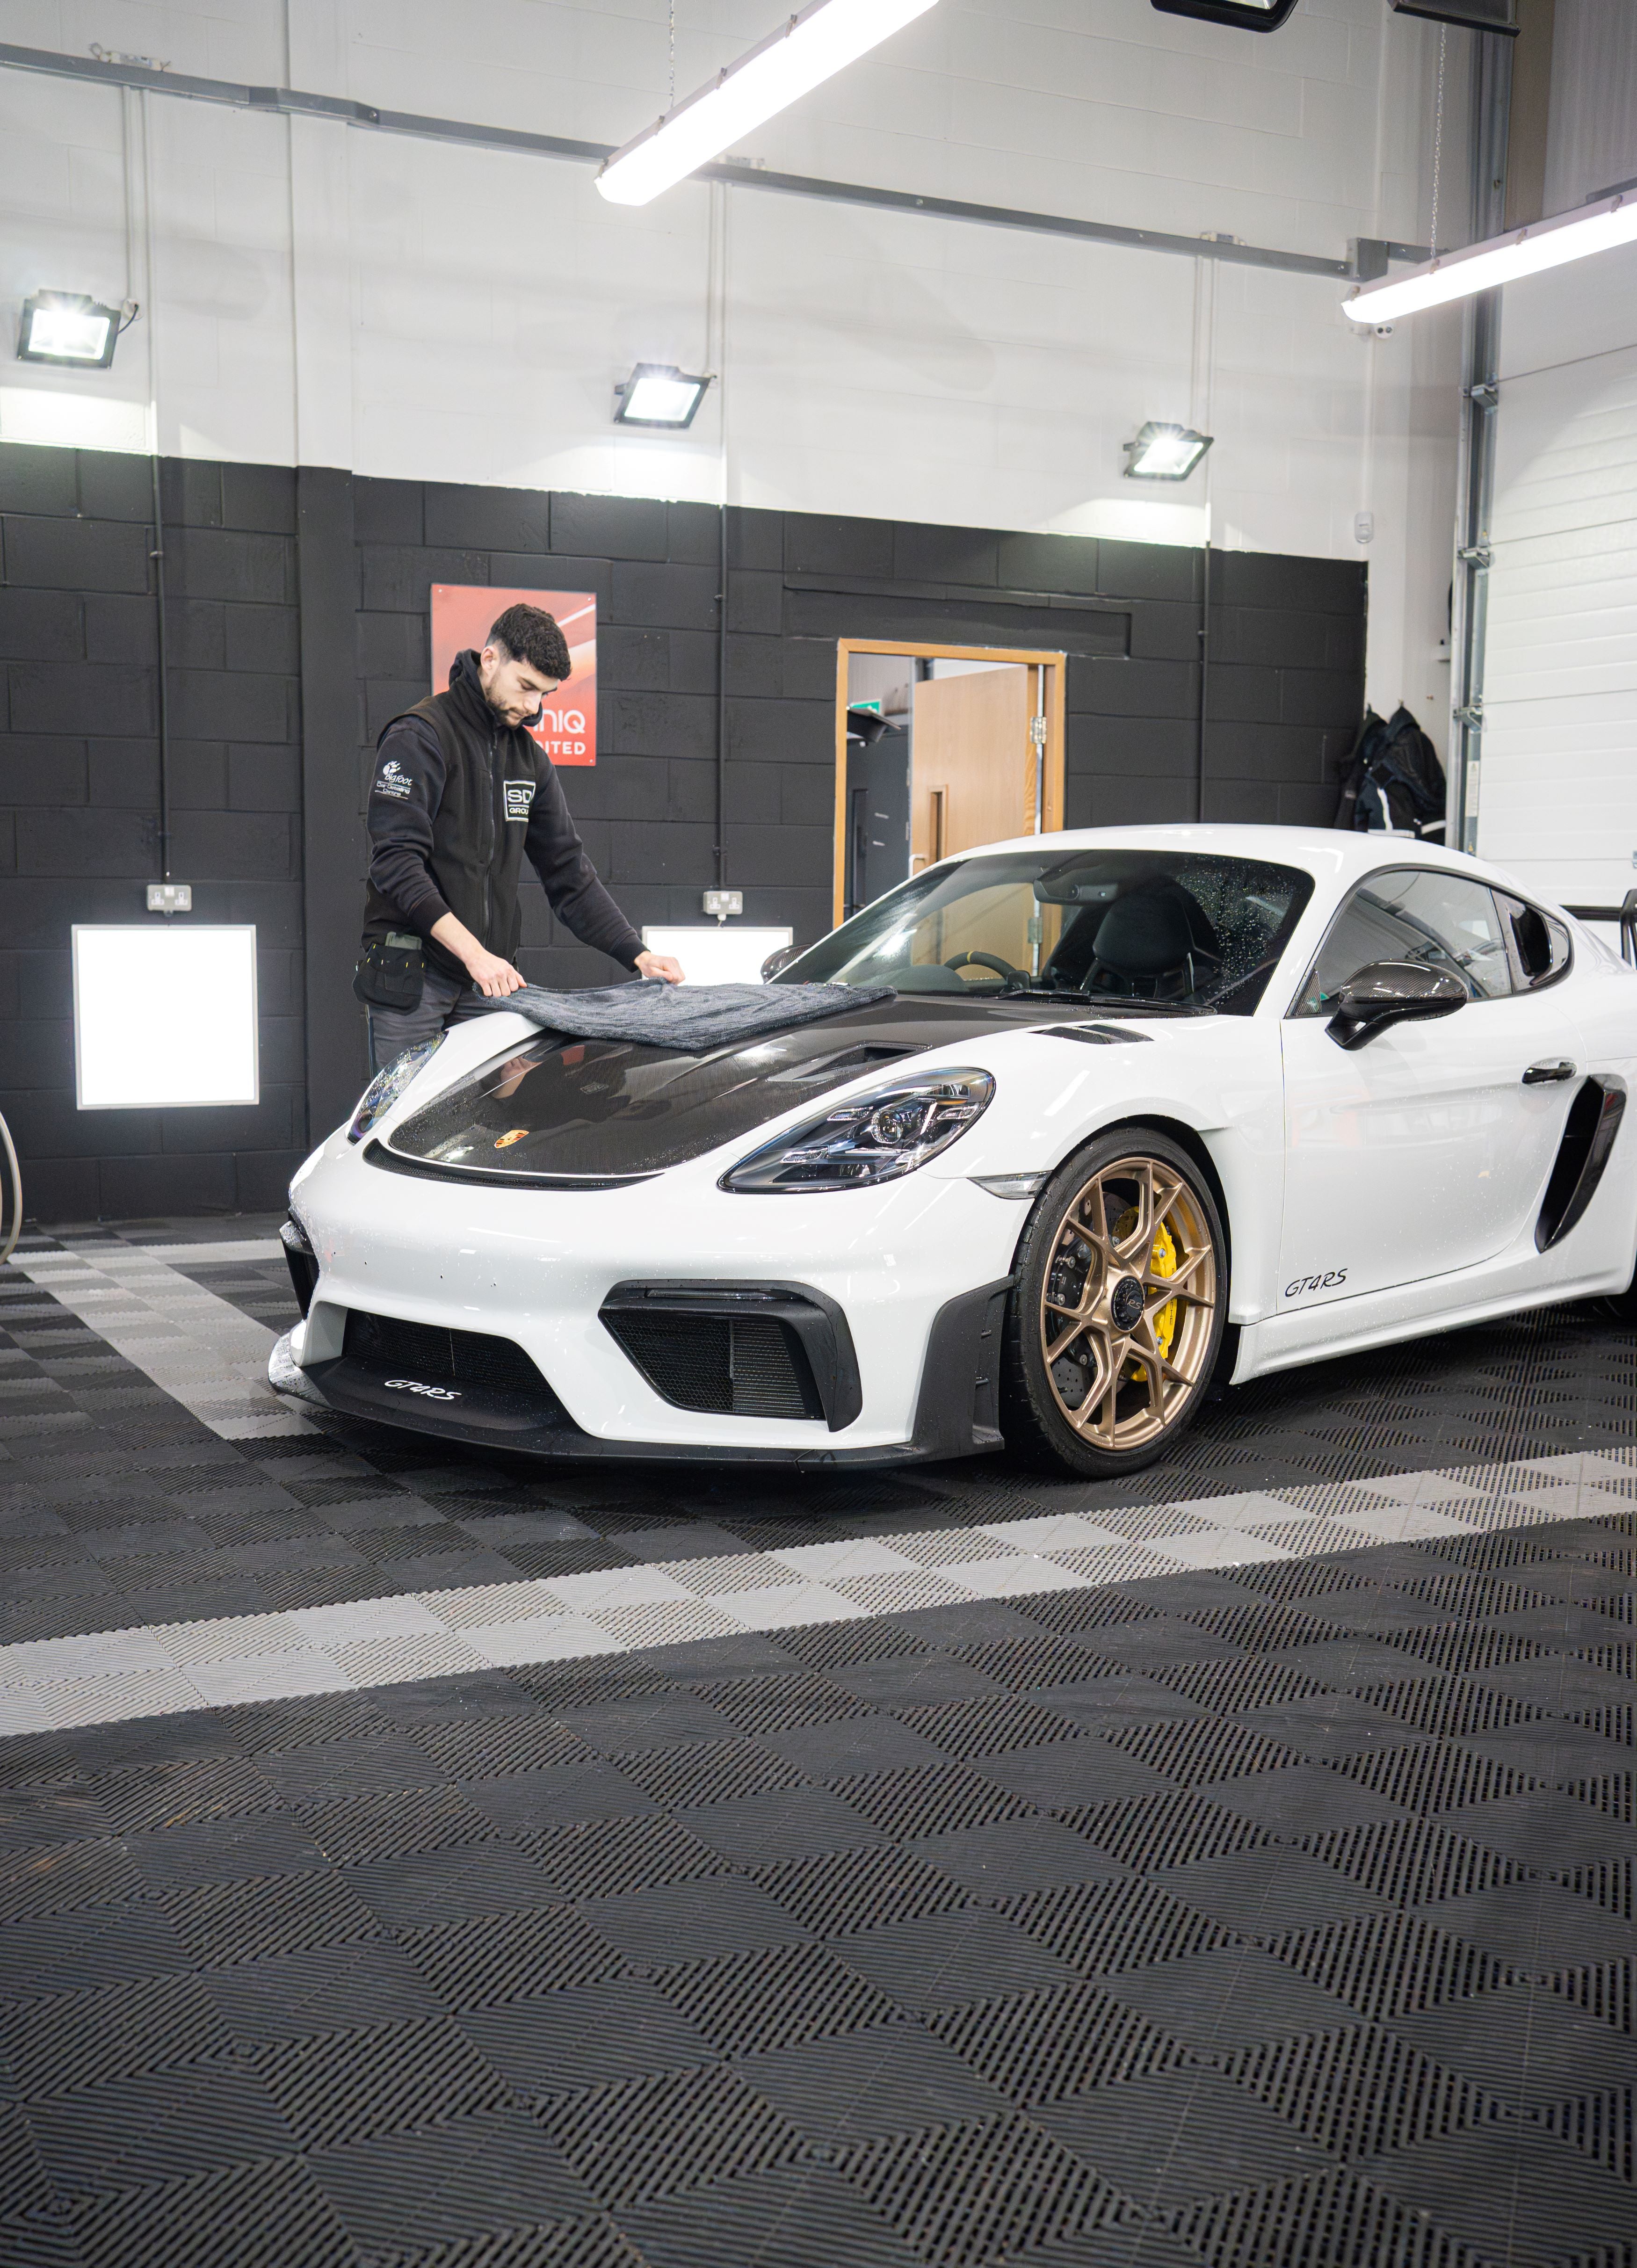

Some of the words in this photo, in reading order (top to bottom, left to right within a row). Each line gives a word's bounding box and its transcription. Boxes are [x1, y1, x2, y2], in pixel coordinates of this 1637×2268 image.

[1285, 1268, 1348, 1297] GT4RS
[1127, 1299, 1142, 1310] RS
[384, 1380, 462, 1400] GT4RS
